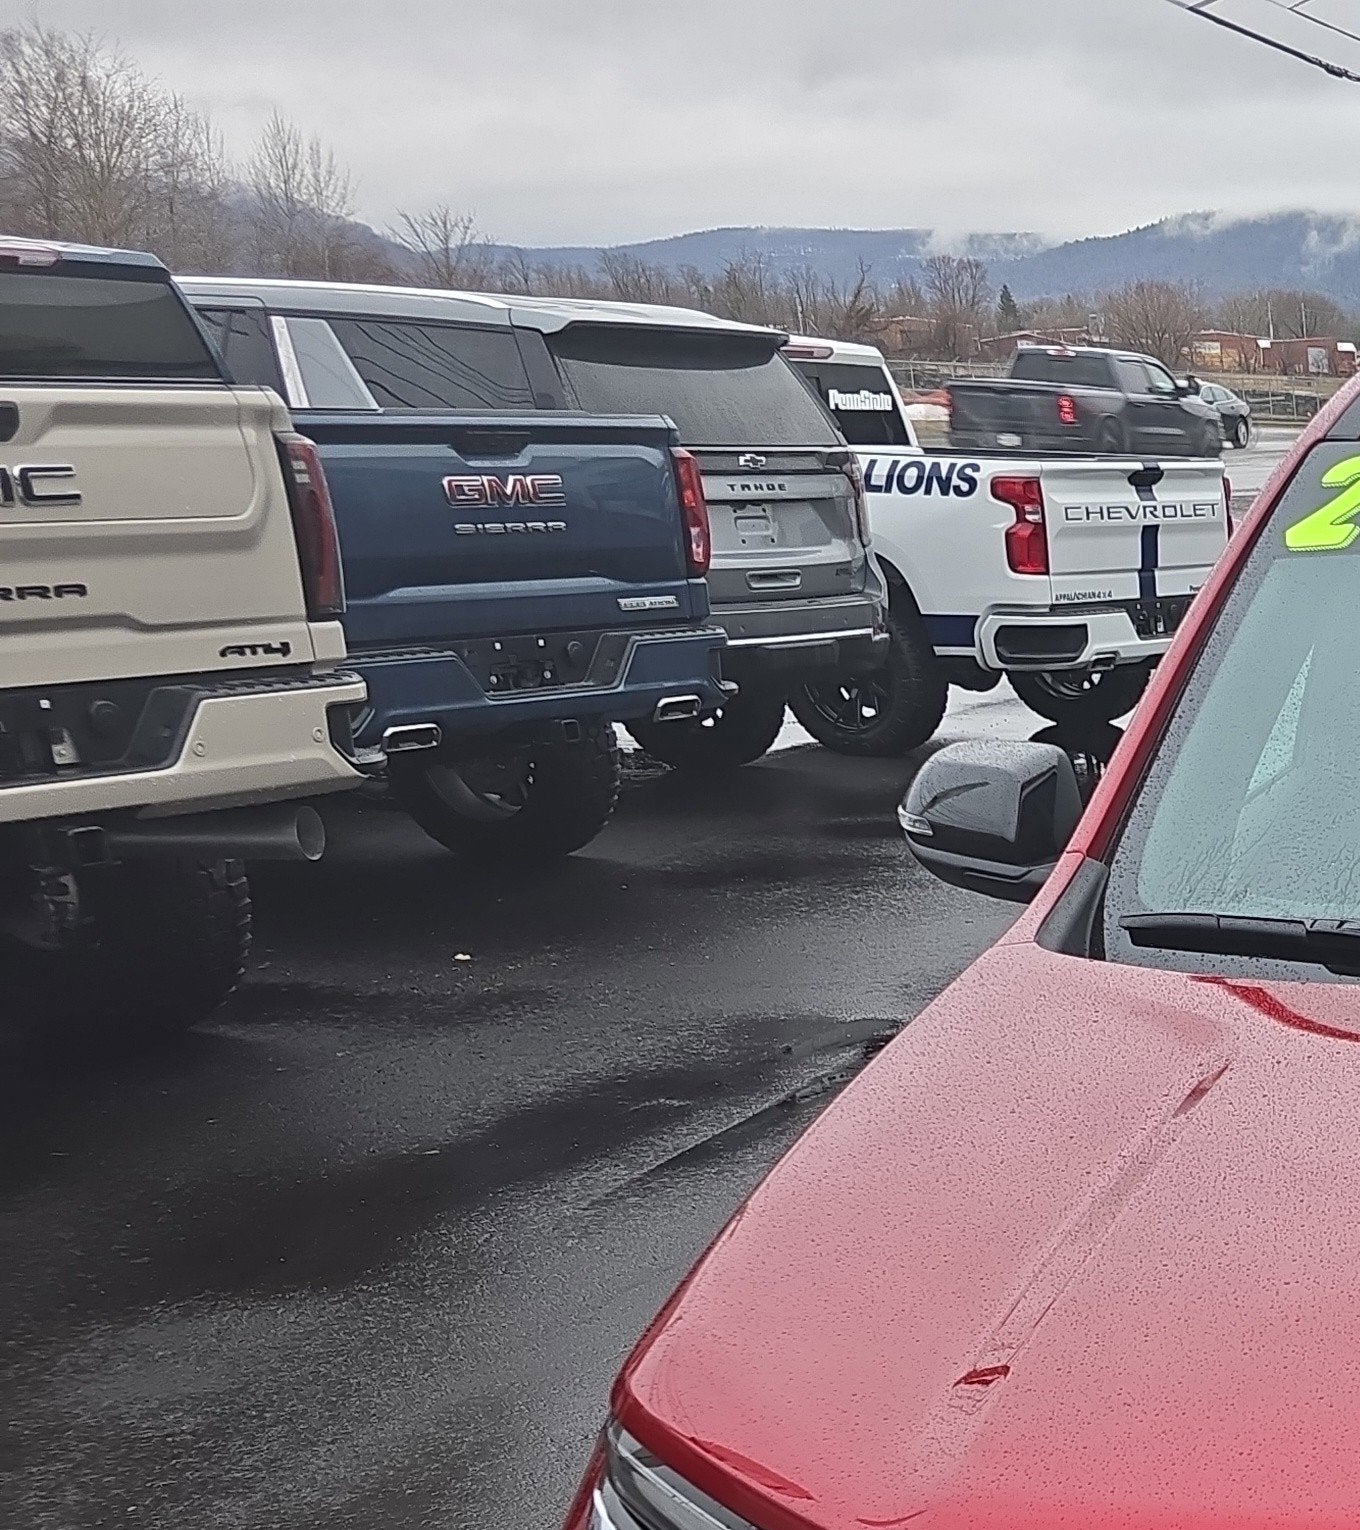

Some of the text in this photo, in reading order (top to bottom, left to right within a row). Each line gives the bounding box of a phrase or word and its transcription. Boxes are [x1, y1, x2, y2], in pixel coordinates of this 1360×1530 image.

[726, 482, 788, 492] TAHOE
[863, 458, 981, 499] LIONS
[442, 474, 567, 508] GMC
[1063, 502, 1220, 522] CHEVROLET
[454, 520, 567, 535] SIERRA
[219, 641, 292, 658] AT4
